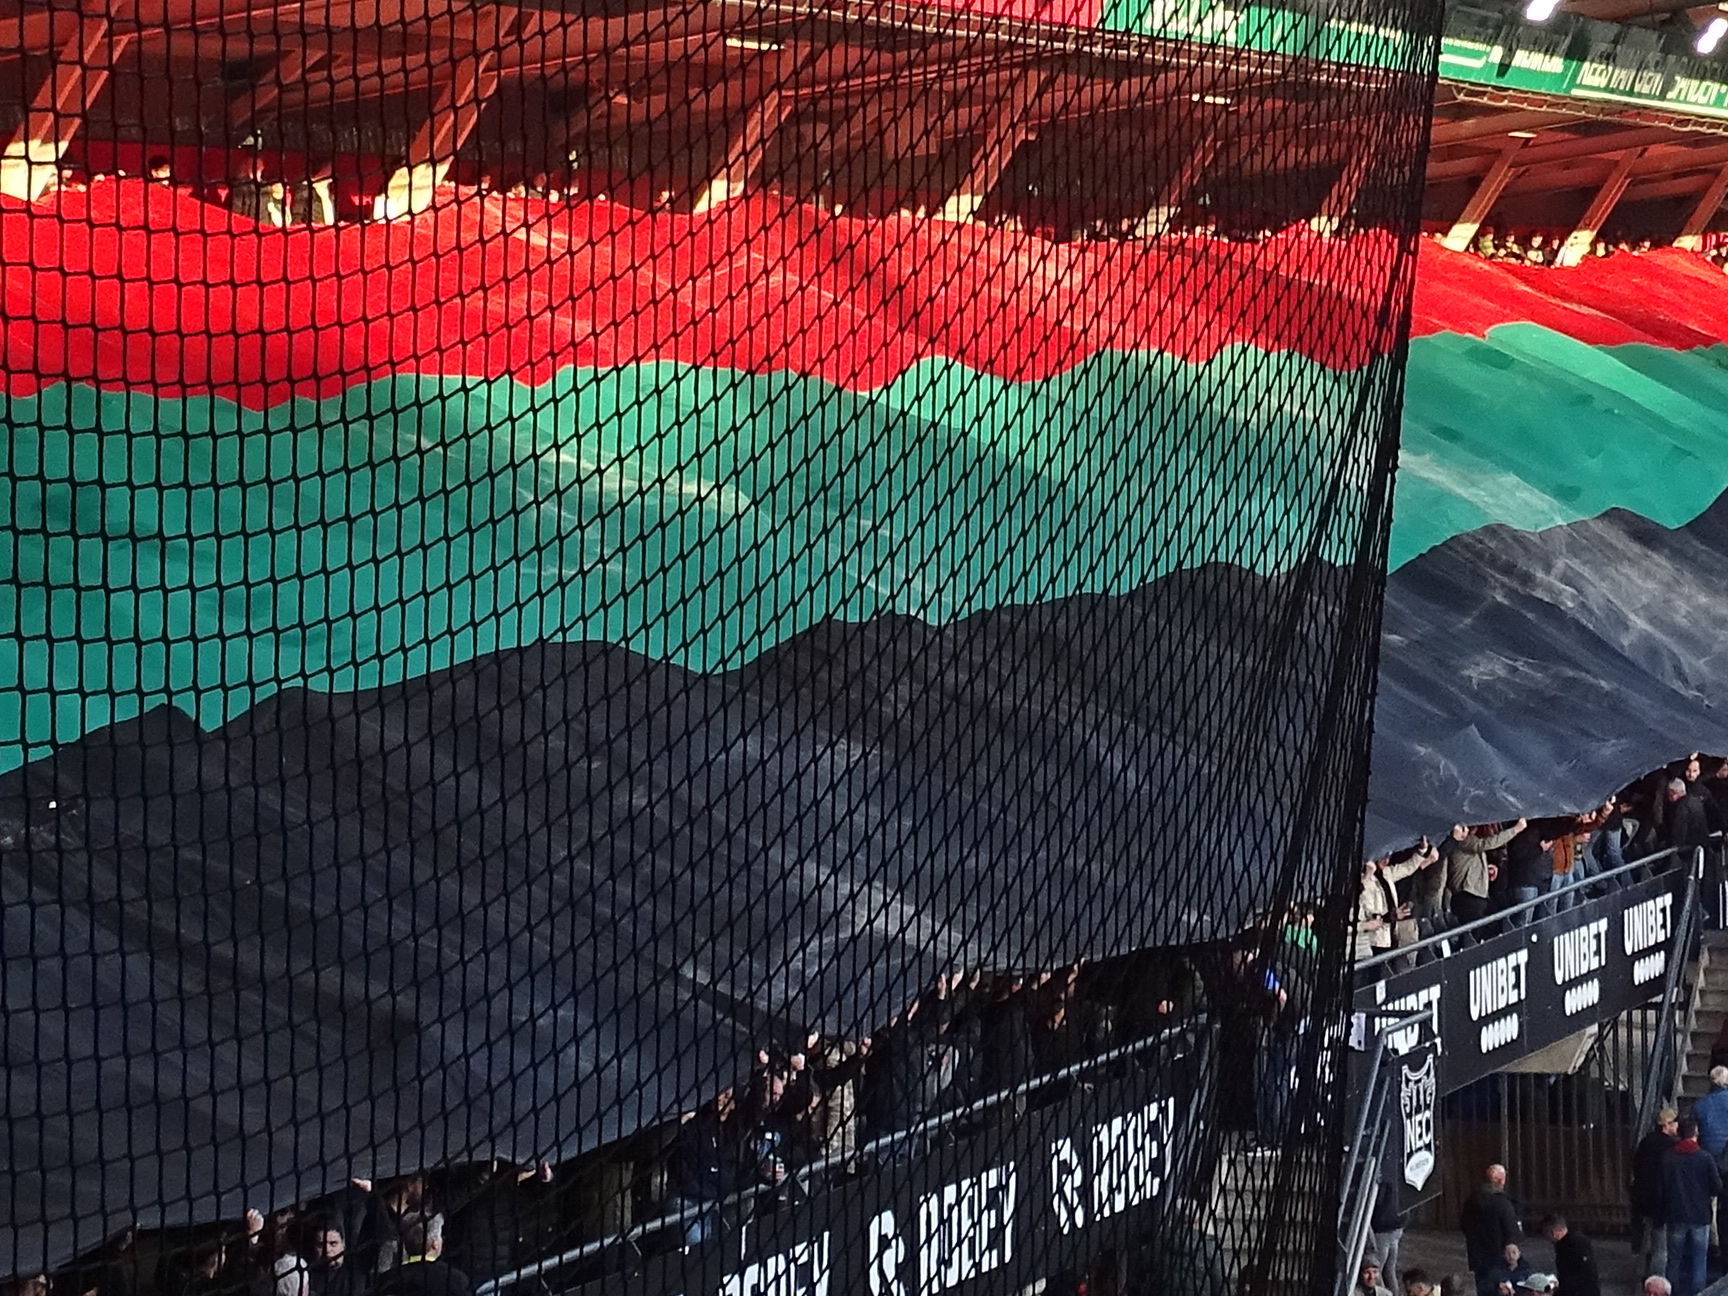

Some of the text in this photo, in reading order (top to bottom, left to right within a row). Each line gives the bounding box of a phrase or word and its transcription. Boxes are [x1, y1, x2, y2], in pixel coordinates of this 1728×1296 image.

[1469, 948, 1529, 1021] UNIBET
[1553, 917, 1608, 985] UNIBET
[1623, 892, 1674, 956] UNIBET
[1092, 1096, 1177, 1223] ROBEY
[1406, 1109, 1432, 1153] NEC
